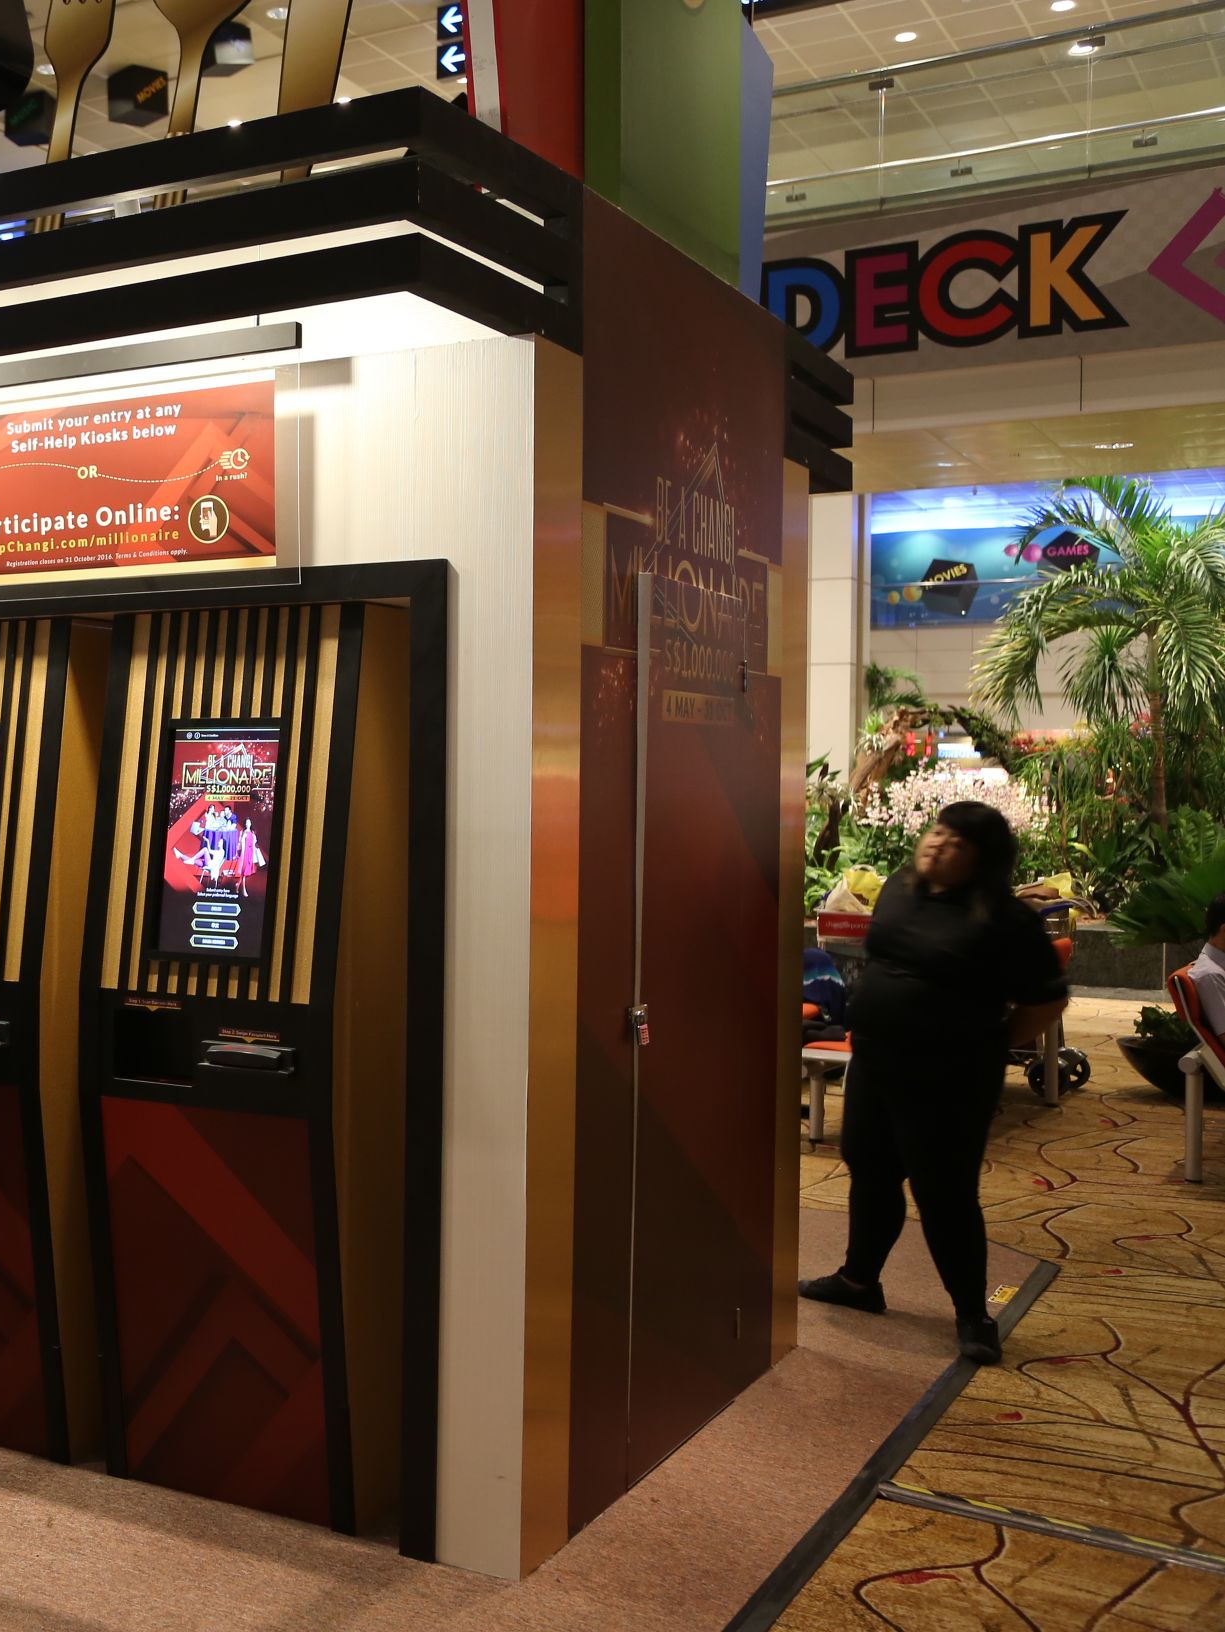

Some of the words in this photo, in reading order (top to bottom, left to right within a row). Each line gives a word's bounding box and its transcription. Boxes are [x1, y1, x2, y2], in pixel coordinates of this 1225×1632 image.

[761, 209, 1130, 358] DECK
[6, 418, 54, 435] Submit
[57, 415, 89, 431] your
[93, 409, 132, 423] entry
[136, 405, 151, 420] at
[155, 403, 182, 418] any
[11, 434, 77, 454] Self-Help
[80, 428, 129, 445] Kiosks
[132, 423, 177, 440] below
[77, 465, 98, 480] OR
[229, 472, 248, 481] rush?
[95, 503, 180, 527] Online:
[656, 476, 672, 546] BE
[679, 486, 687, 550] A
[692, 491, 736, 567] CHANGI
[6, 559, 39, 568] Registration
[73, 554, 96, 563] October
[115, 551, 132, 560] Terms
[138, 549, 170, 558] Conditions
[170, 547, 188, 557] apply.
[1046, 544, 1090, 558] GAMES
[666, 694, 672, 714] 4
[674, 695, 696, 719] MAY
[208, 755, 216, 767] BE
[227, 754, 254, 768] CHANGI
[185, 768, 271, 784] MILLIONAIRE
